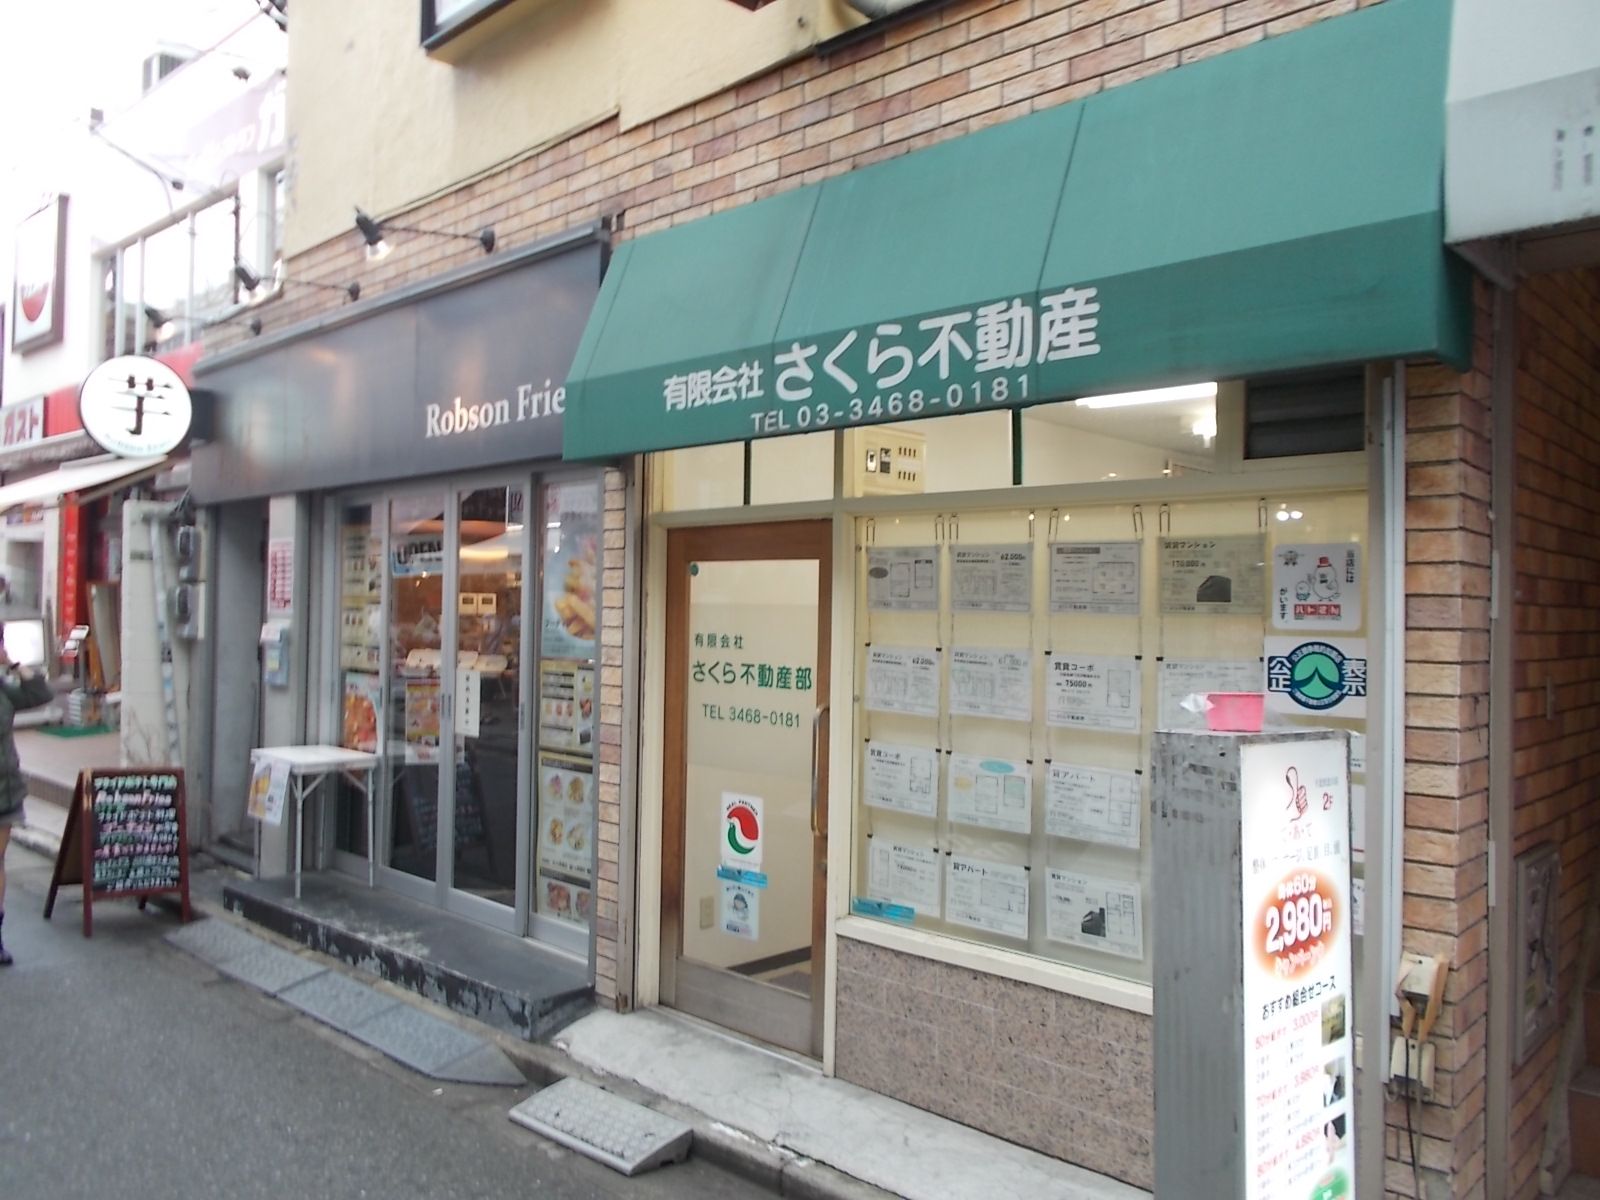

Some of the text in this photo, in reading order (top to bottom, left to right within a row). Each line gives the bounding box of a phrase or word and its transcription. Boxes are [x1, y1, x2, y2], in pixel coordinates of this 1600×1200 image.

[663, 287, 1101, 412] 有限会社 さくら不動産
[425, 378, 566, 438] Robson Frie
[751, 374, 1029, 433] TEL 03-3468-0181
[694, 633, 744, 649] 有限会社
[693, 660, 812, 691] さくら不動産部
[1269, 657, 1292, 692] 公正
[1342, 660, 1367, 696] 表示
[702, 703, 800, 728] TEL 3468-0181
[1262, 975, 1337, 1022] おすすめ組合せコース
